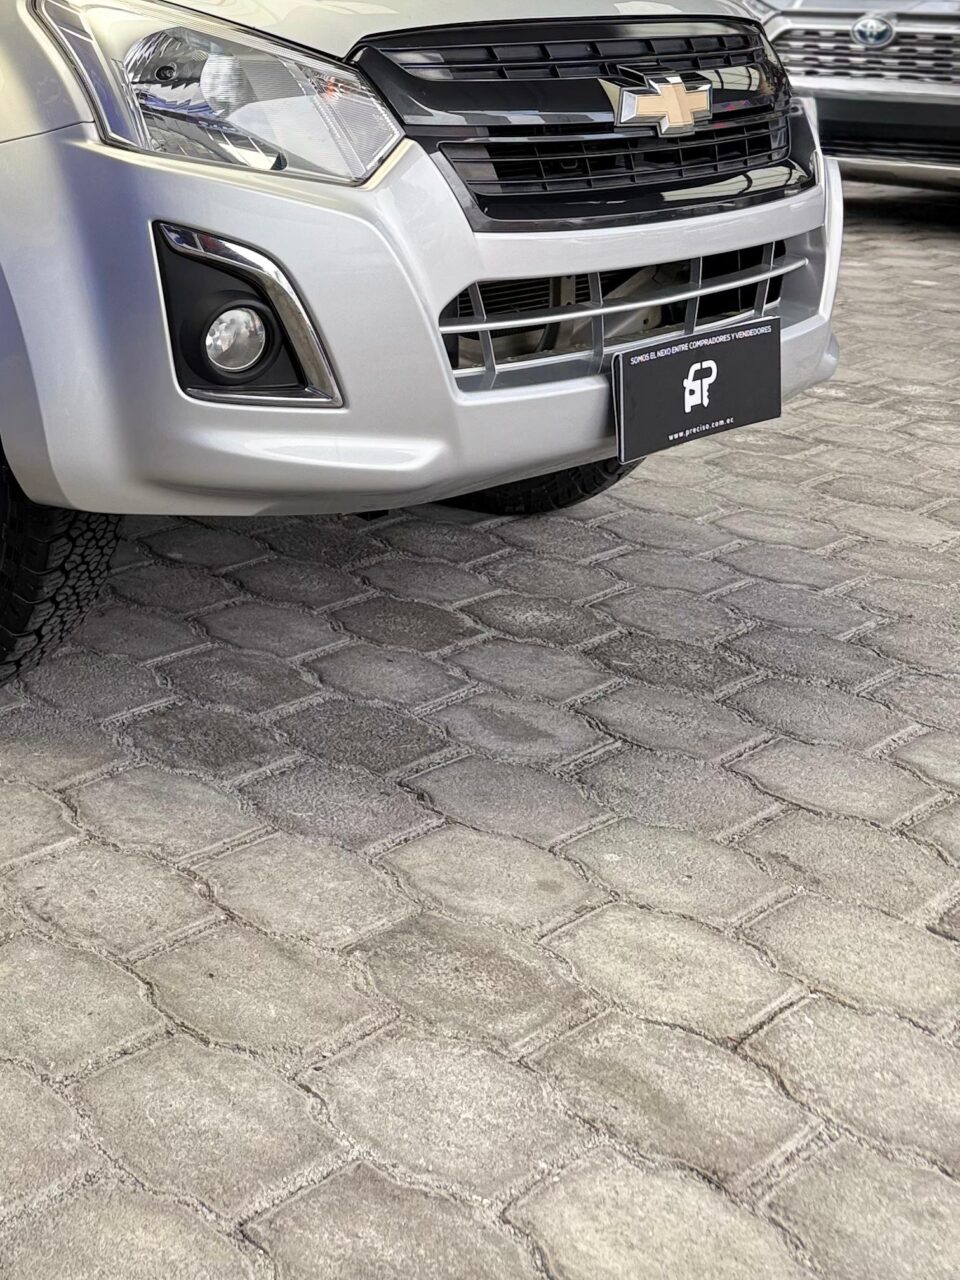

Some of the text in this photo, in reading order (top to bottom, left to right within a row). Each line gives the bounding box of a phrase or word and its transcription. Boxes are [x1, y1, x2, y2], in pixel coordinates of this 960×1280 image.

[630, 352, 650, 366] SOMOS
[650, 351, 657, 360] EL
[657, 347, 672, 358] NEXO
[671, 342, 689, 354] ENTRE
[689, 333, 731, 350] COMPRADORES
[735, 325, 772, 340] VENDEDORES
[668, 417, 734, 441] www.preciso.com.ec
